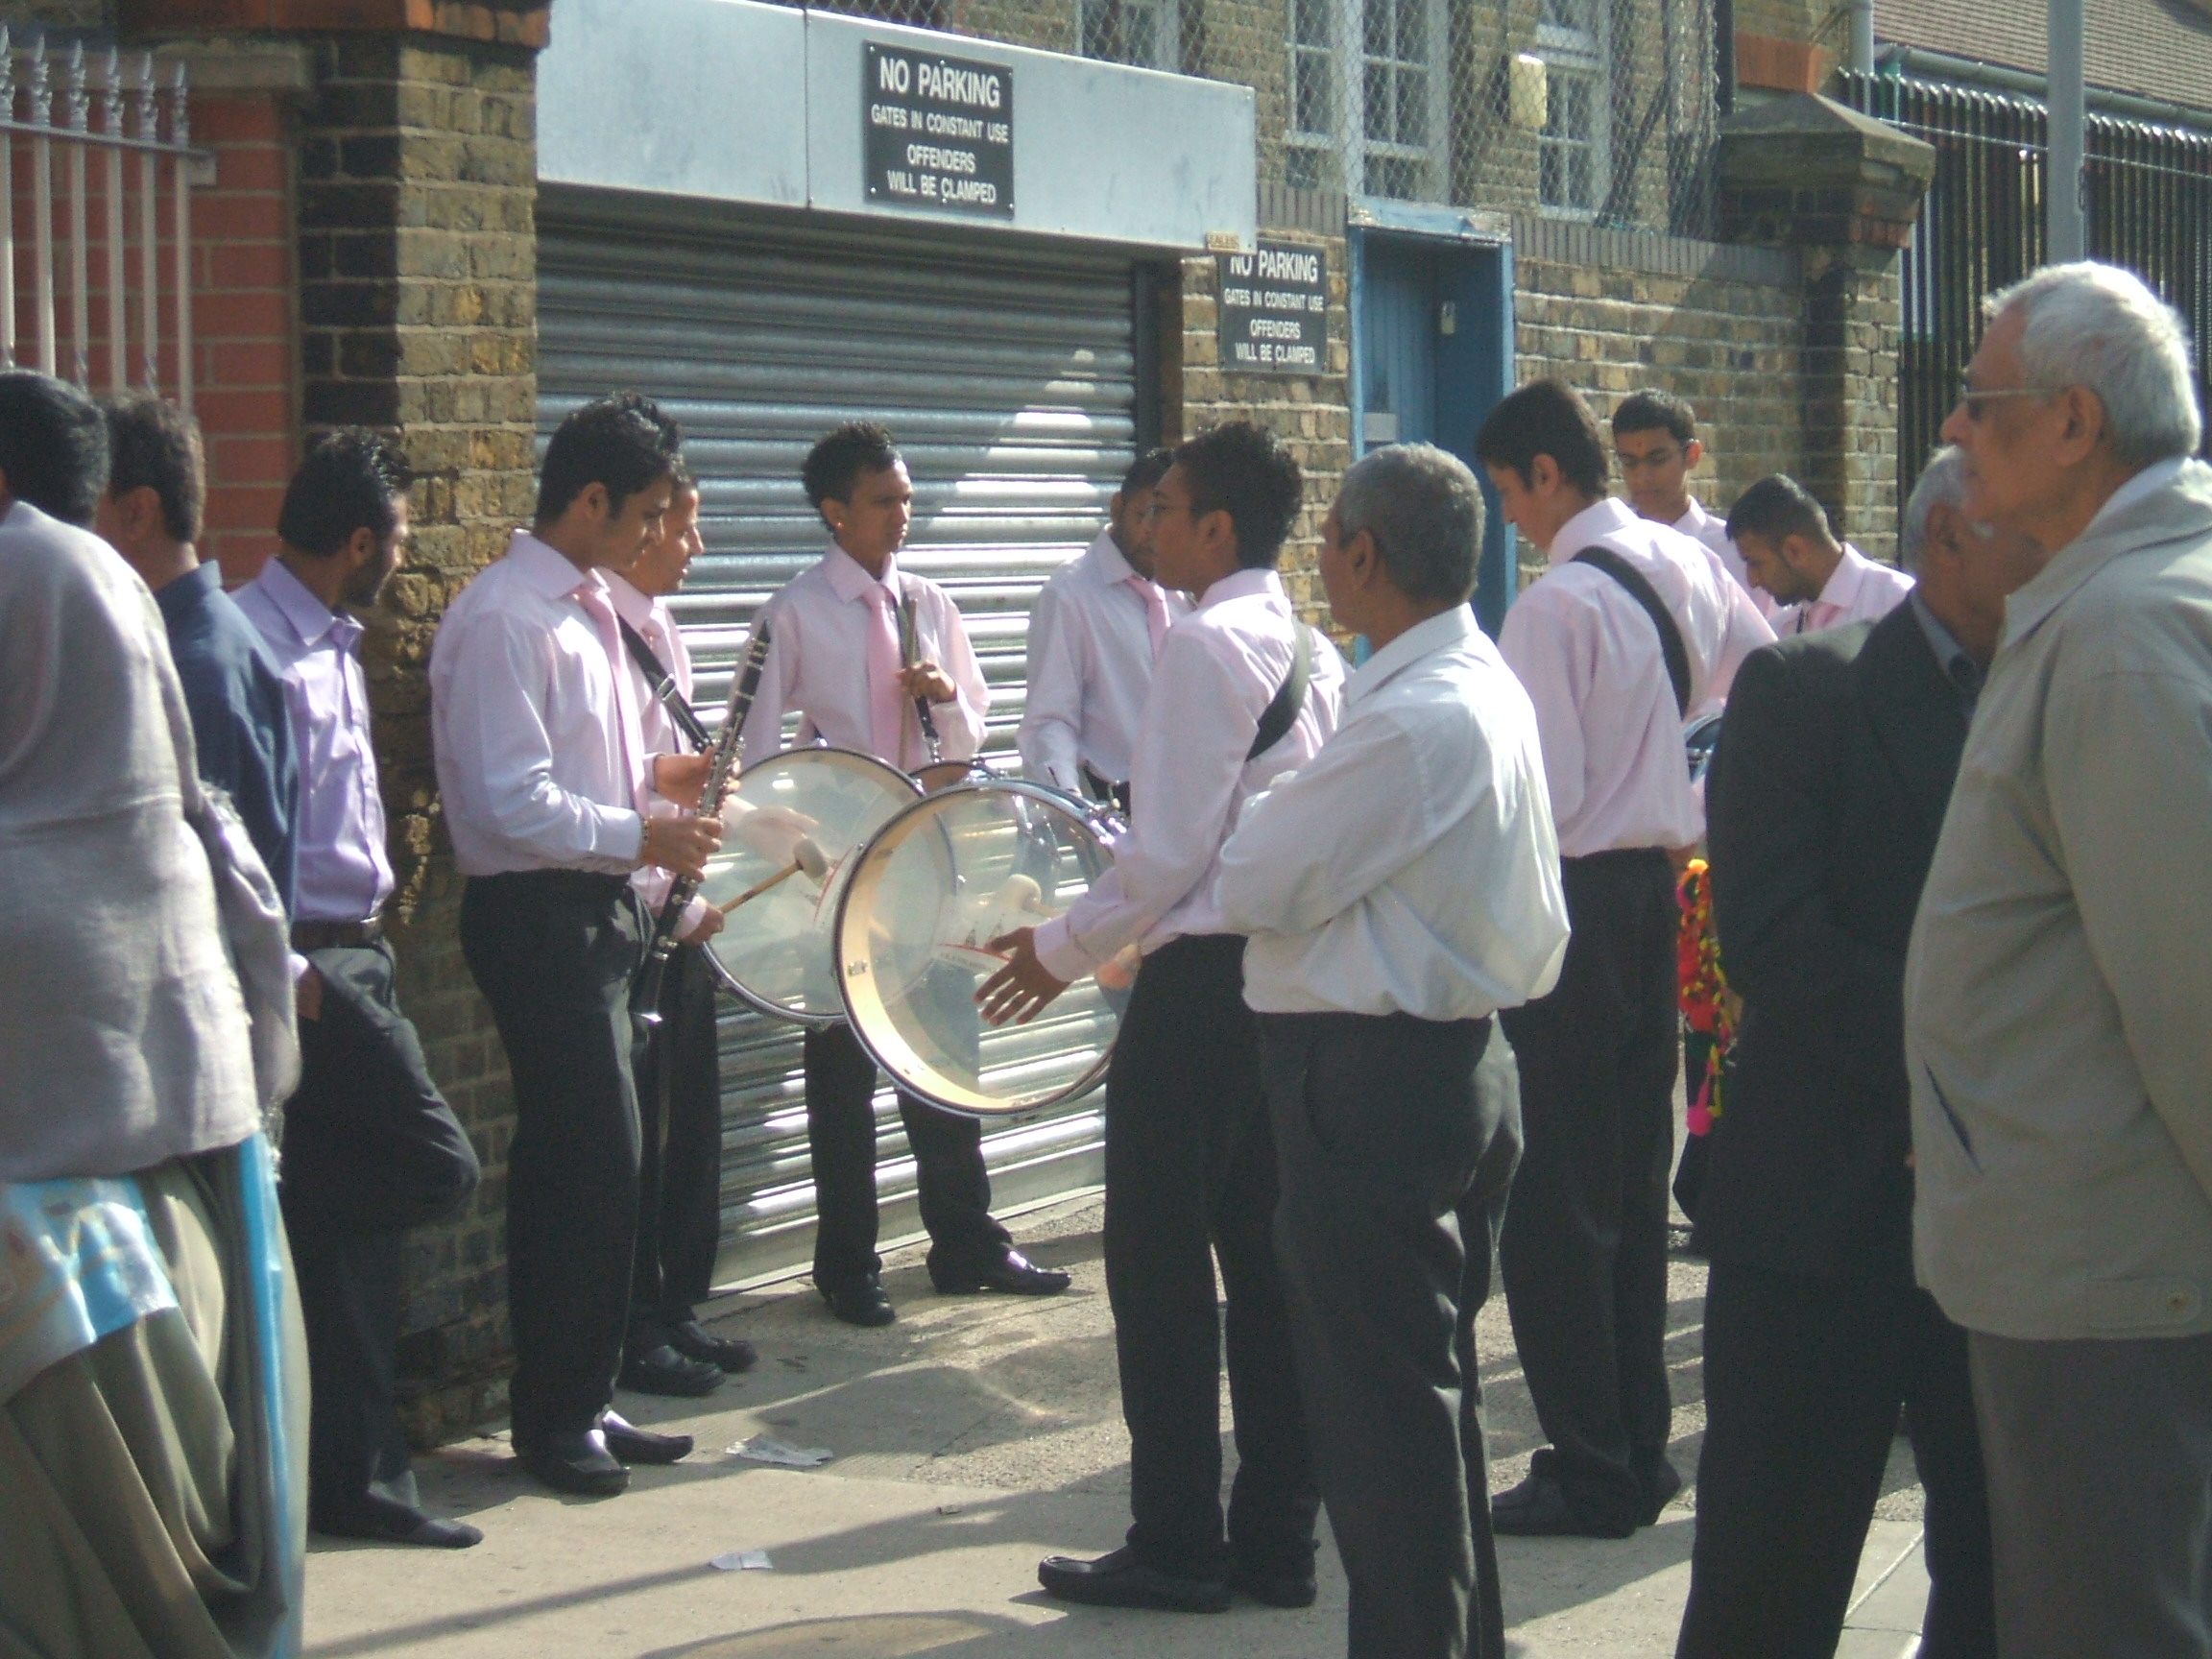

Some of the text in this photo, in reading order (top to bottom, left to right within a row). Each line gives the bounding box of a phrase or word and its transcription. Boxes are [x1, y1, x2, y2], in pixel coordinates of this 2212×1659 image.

[880, 57, 1000, 108] NO PARKING
[871, 104, 1009, 143] GATES IN CONSTANT USE
[907, 144, 976, 174] OFFENDERS
[887, 170, 997, 204] WILL BE CLAMPED
[1230, 250, 1318, 283] NO PARKING
[1224, 287, 1324, 312] GATES IN CONSTANT USE
[1250, 319, 1302, 340] OFFENDERS
[1235, 342, 1315, 364] WILL BE CLAMPED
